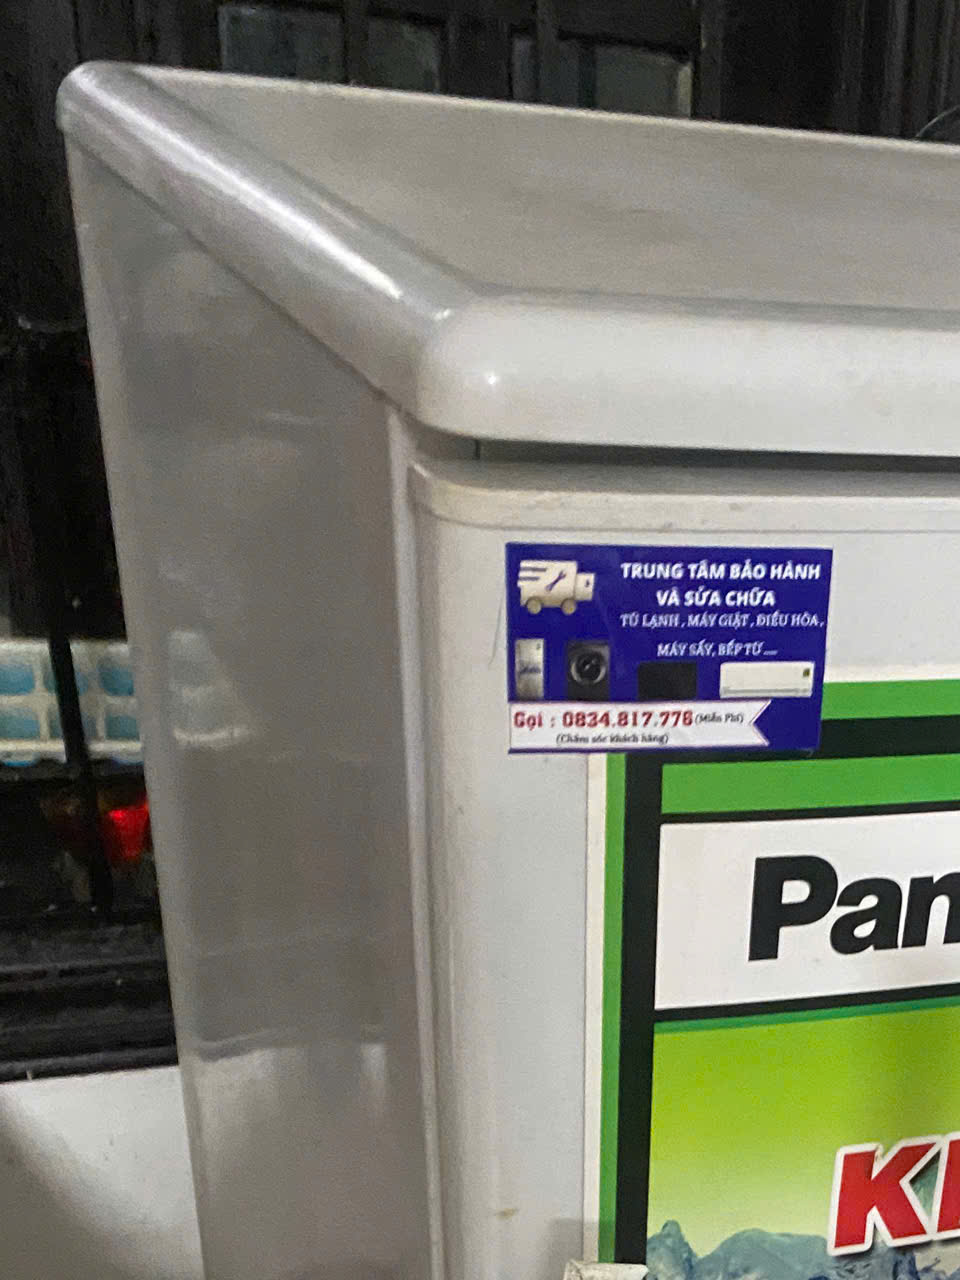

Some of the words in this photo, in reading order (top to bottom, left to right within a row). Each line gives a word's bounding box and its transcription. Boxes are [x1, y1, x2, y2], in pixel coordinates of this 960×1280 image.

[620, 562, 683, 579] TRUNG
[687, 560, 724, 579] TÂM
[729, 559, 767, 579] BẢO
[770, 559, 821, 579] HÀNH
[656, 587, 679, 607] VÀ
[684, 585, 721, 607] SỬA
[725, 586, 776, 607] CHỮA
[620, 612, 638, 627] TỦ
[687, 612, 717, 628] MÁY
[756, 610, 788, 627] ĐIỀU
[657, 642, 684, 656] MÁY
[513, 712, 543, 731] Gọi
